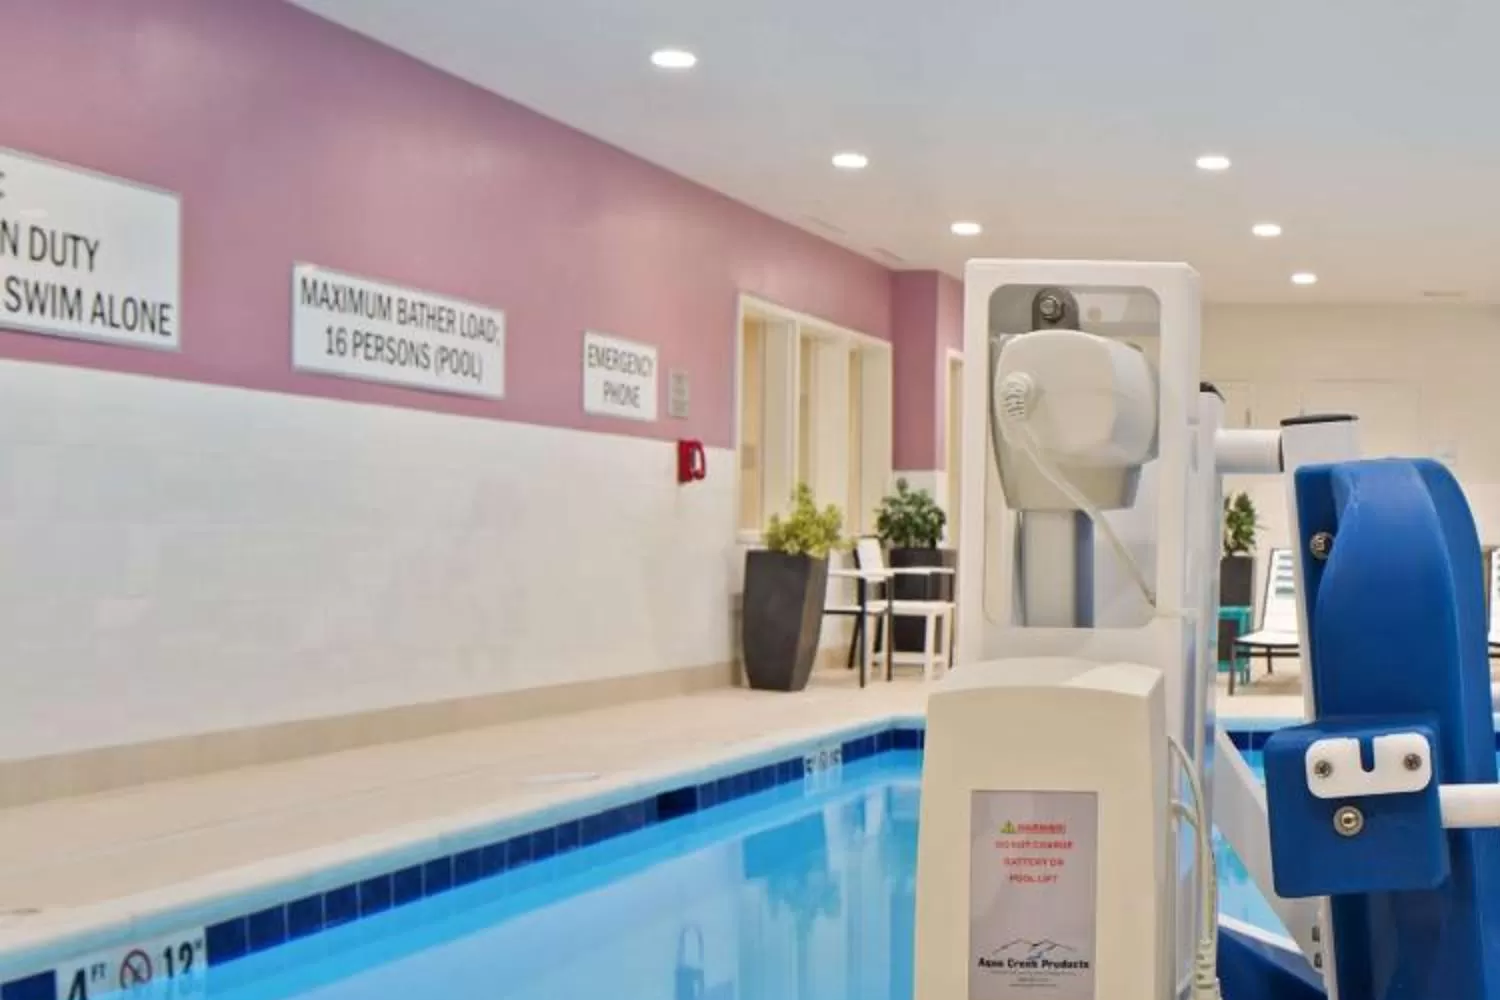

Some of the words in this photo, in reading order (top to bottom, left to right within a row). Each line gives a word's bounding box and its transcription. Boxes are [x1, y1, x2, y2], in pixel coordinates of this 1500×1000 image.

[29, 224, 100, 272] DUTY
[4, 275, 82, 322] SWIM
[90, 291, 172, 337] ALONE
[300, 277, 392, 321] MAXIMUM
[397, 297, 455, 335] BATHER
[325, 325, 348, 357] 16
[352, 329, 430, 370] PERSONS
[434, 345, 483, 383] (POOL)
[587, 343, 654, 377] EMERGENCY
[603, 380, 640, 408] PHONE
